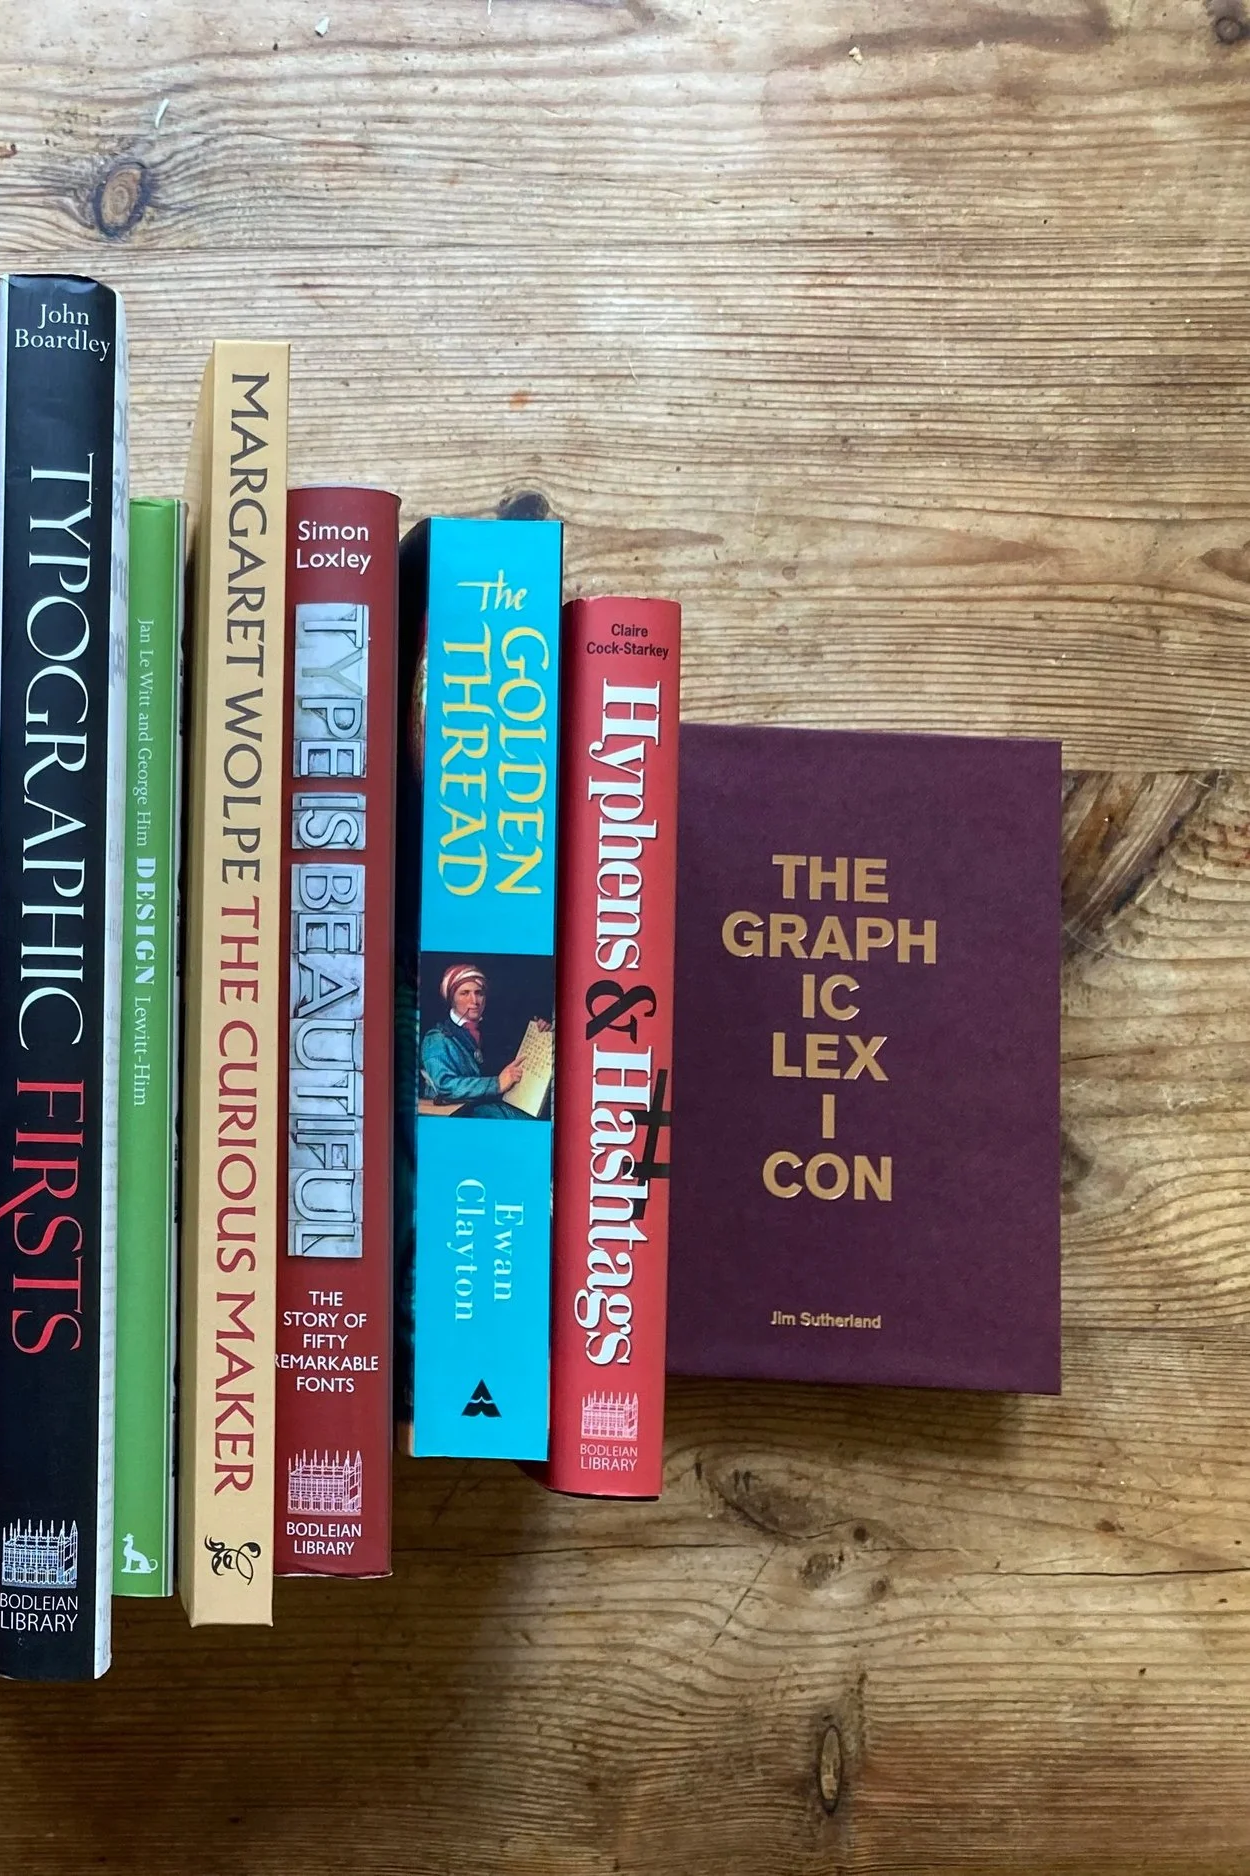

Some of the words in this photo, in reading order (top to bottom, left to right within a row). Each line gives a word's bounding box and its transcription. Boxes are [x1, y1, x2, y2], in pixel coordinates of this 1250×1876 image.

[37, 303, 90, 329] John
[14, 329, 111, 362] Boardley
[224, 373, 271, 678] MARGARET
[297, 520, 370, 542] Simon
[296, 547, 372, 577] Loxley
[457, 569, 528, 612] The
[138, 618, 154, 643] Jan
[586, 641, 669, 660] Cock-Starkey
[611, 624, 648, 637] Claire
[139, 650, 154, 667] Le
[139, 672, 154, 707] Witt
[298, 604, 366, 778] TYPE
[18, 452, 94, 1050] TYPOGRAPHIC
[138, 714, 154, 741] and
[133, 748, 152, 805] George
[437, 622, 496, 897] THREAD
[494, 626, 550, 895] GOLDEN
[221, 688, 264, 884] WOLPE
[136, 811, 151, 846] Him
[298, 795, 360, 848] IS
[588, 677, 661, 972] Hyphens
[772, 854, 889, 903] THE
[135, 856, 156, 985] DESIGN
[721, 911, 937, 964] GRAPH
[218, 894, 261, 1005] THE
[585, 980, 657, 1044] &
[802, 973, 860, 1021] IC
[134, 996, 151, 1106] Lewitt-Him
[293, 866, 362, 1257] BEAUTIFUL
[772, 1032, 889, 1081] LEX
[822, 1093, 836, 1139] I
[215, 1018, 260, 1272] CURIOUS
[762, 1151, 892, 1201] CON
[574, 1045, 653, 1365] Hashtags
[446, 1178, 487, 1322] Clayton
[493, 1201, 525, 1302] Ewan
[283, 1312, 339, 1328] STORY
[344, 1313, 367, 1328] OF
[309, 1291, 343, 1307] THE
[770, 1311, 795, 1326] Jim
[800, 1311, 882, 1329] Sutherland
[303, 1334, 348, 1350] FIFTY
[212, 1291, 258, 1496] MAKER
[296, 1376, 354, 1393] FONTS
[580, 1444, 638, 1457] BODLEIAN
[580, 1457, 638, 1473] LIBRARY
[286, 1522, 362, 1538] BODLEIAN
[294, 1540, 354, 1556] LIBRARY
[0, 1593, 79, 1611] BODLEIAN
[0, 1611, 79, 1632] LIBRARY
